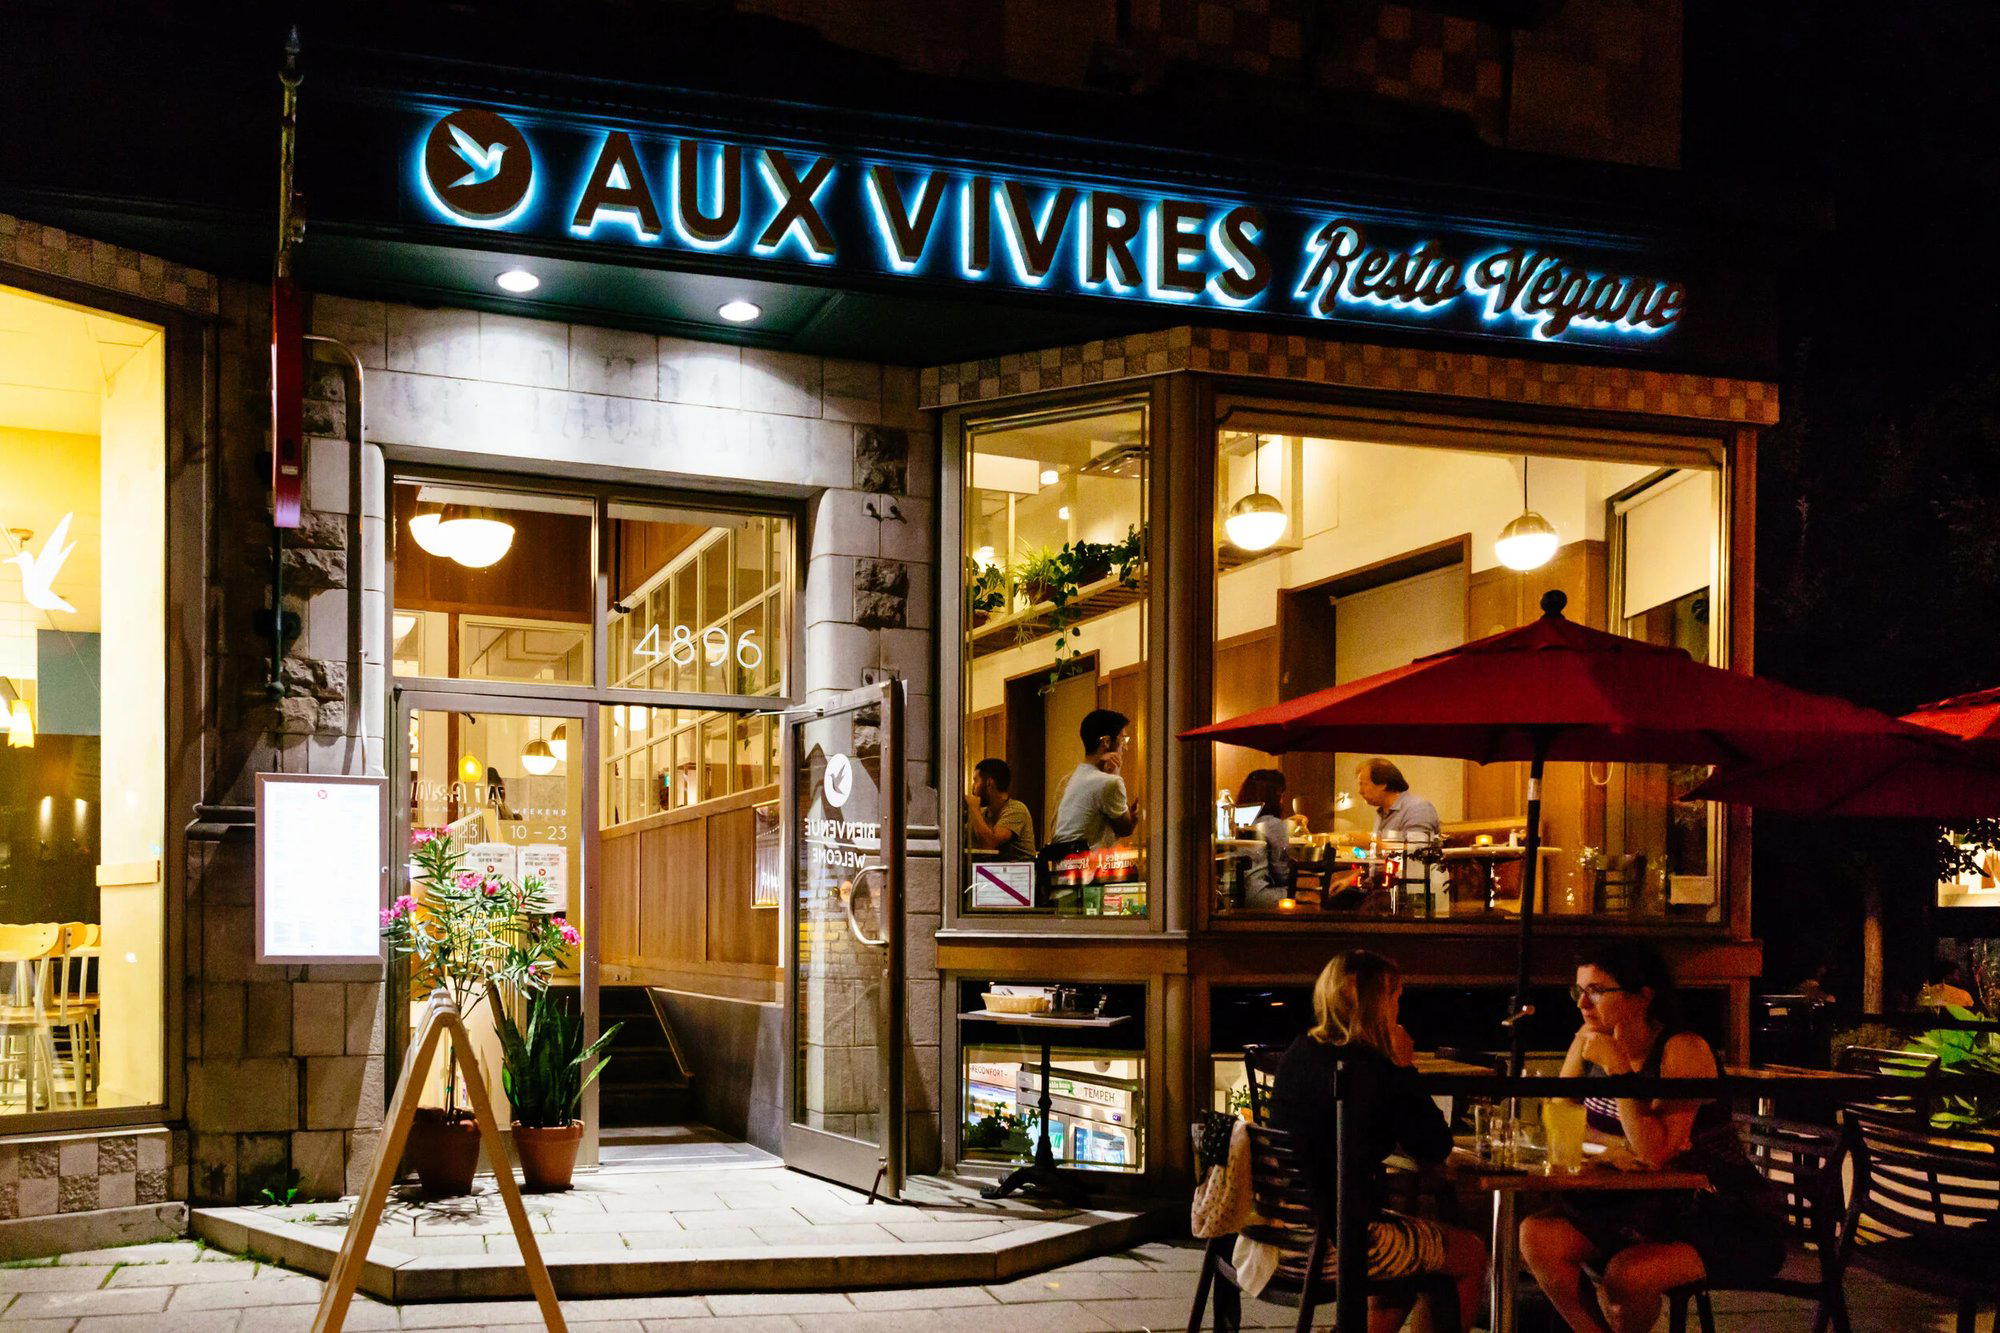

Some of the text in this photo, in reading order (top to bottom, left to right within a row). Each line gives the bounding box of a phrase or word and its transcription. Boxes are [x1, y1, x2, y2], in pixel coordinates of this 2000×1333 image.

[571, 130, 1267, 310] AUX VIVRES
[1295, 217, 1468, 317] Resto
[633, 623, 763, 669] 4896
[512, 808, 567, 816] WEEKEND
[511, 824, 528, 840] 10
[546, 825, 568, 841] 23
[1083, 1086, 1116, 1103] TEMPEH
